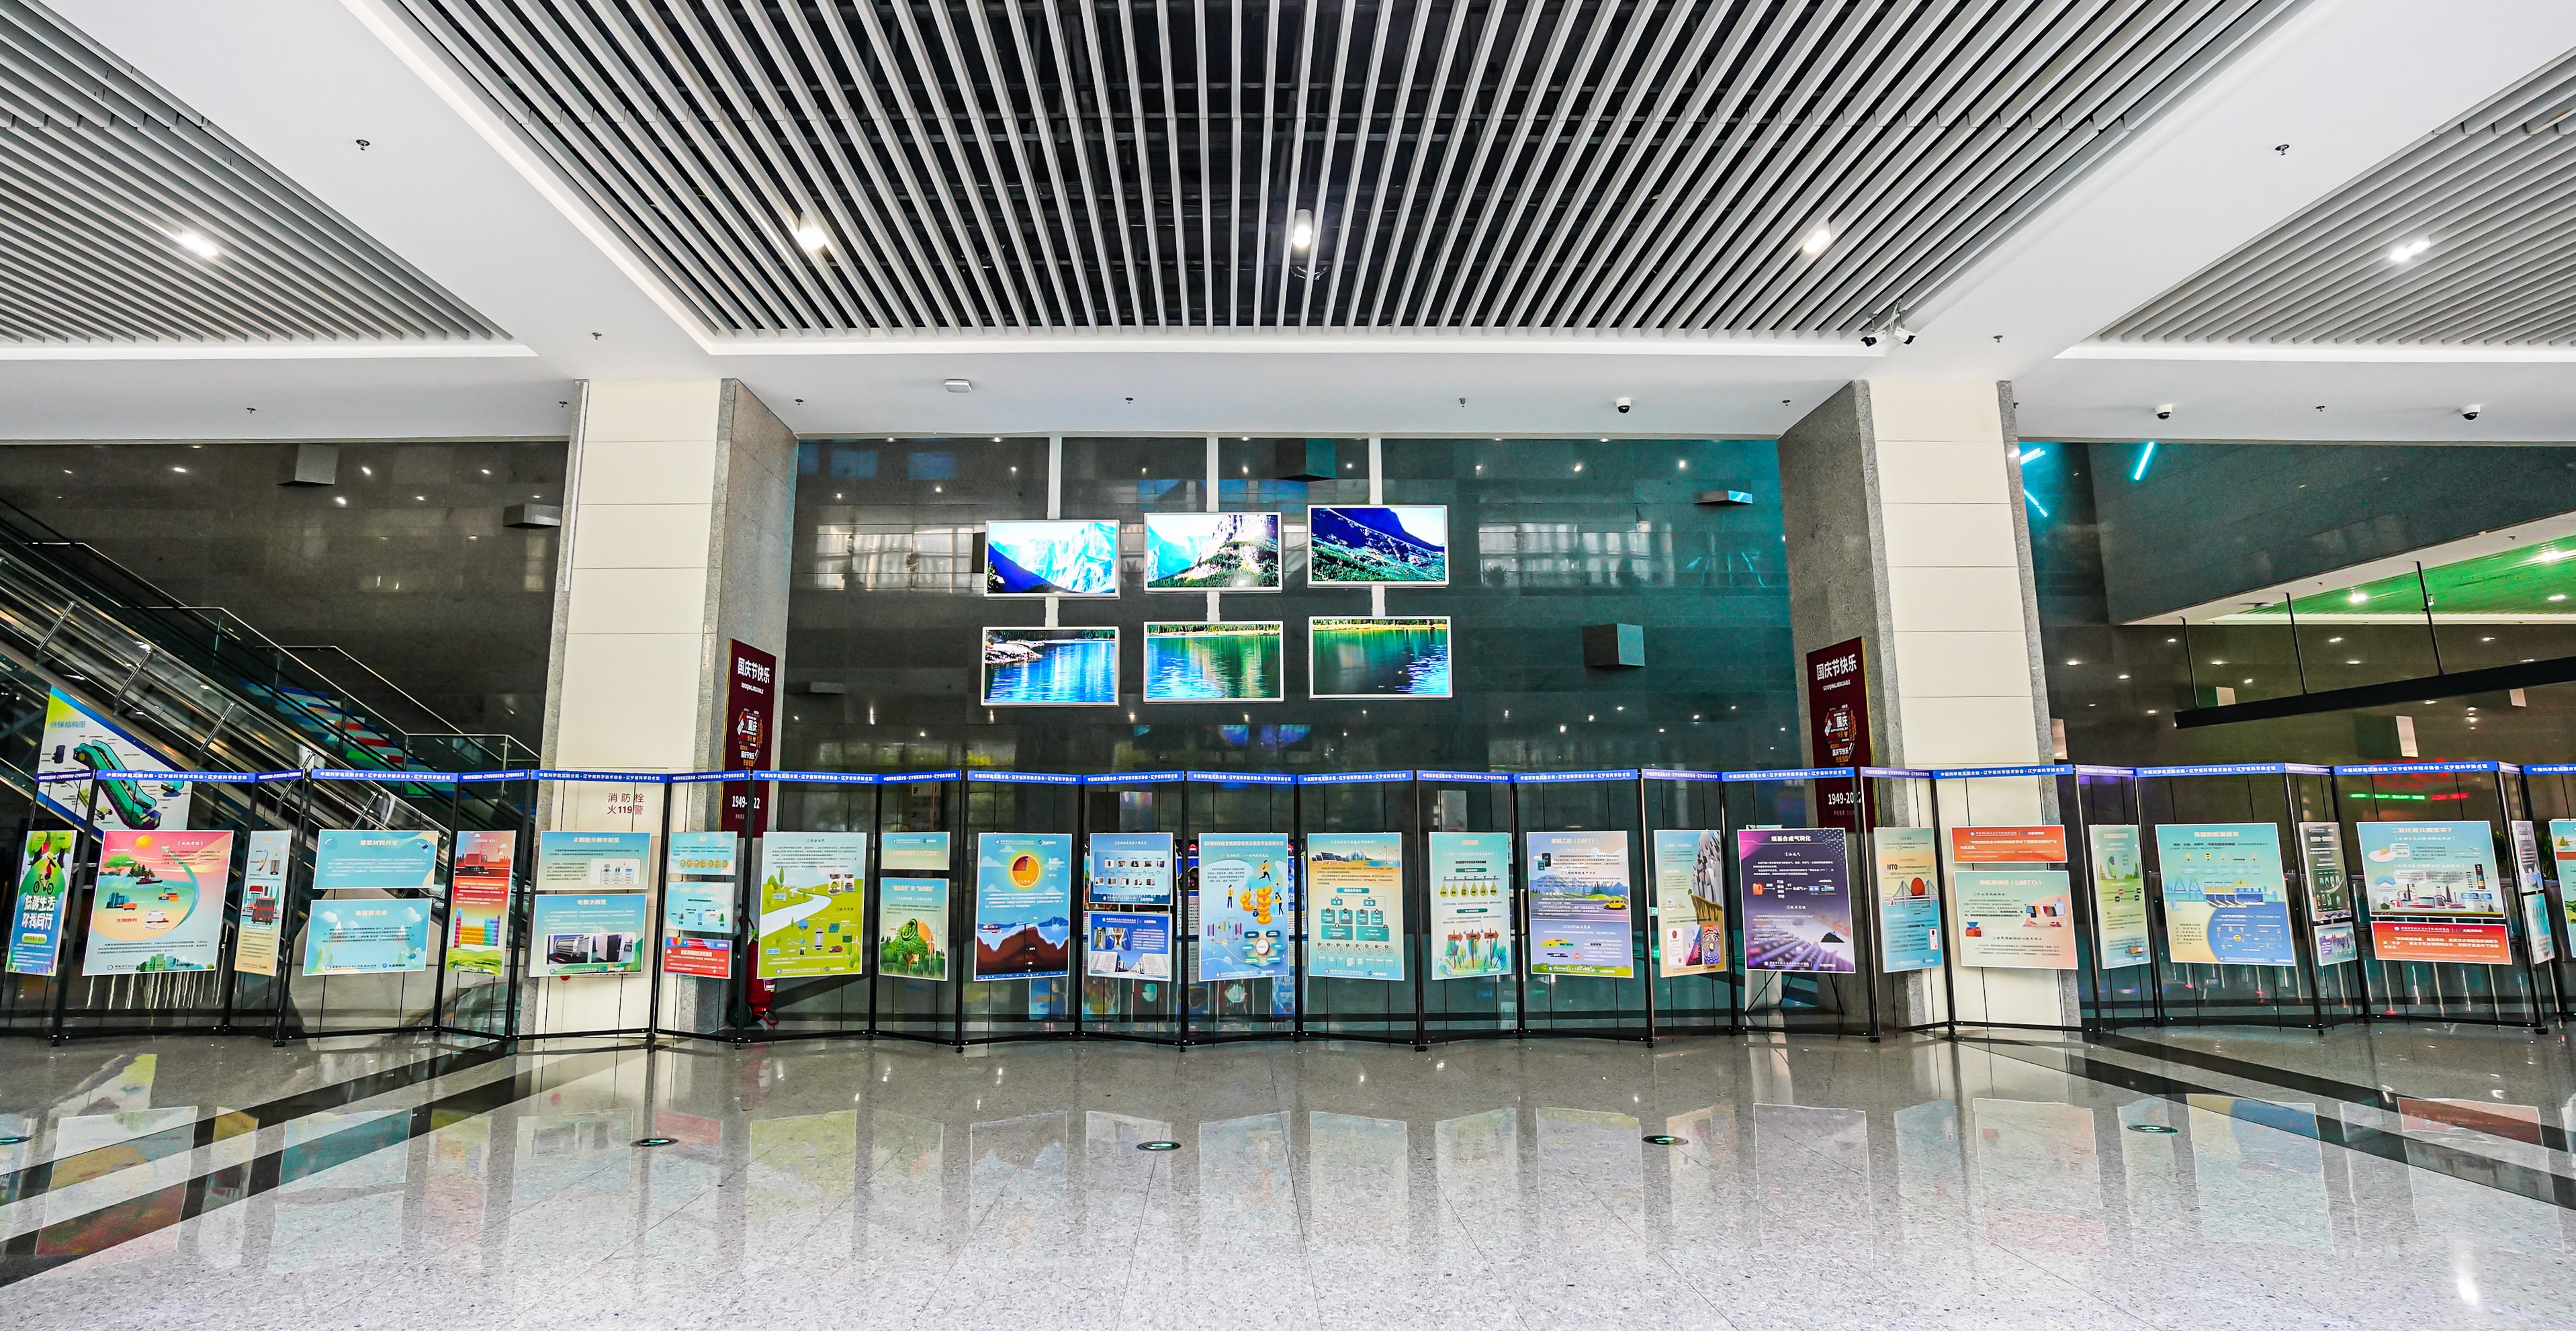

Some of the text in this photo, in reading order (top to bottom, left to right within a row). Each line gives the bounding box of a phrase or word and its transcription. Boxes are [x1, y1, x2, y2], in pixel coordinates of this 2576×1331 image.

[738, 657, 770, 684] 国庆节快乐
[1816, 653, 1857, 680] 国庆节快乐
[748, 720, 758, 732] 国庆
[1836, 715, 1848, 728] 国庆
[608, 793, 644, 802] 消防栓
[732, 796, 760, 809] 1949-22
[24, 894, 56, 912] 低碳生活
[21, 912, 53, 931] 你我同行
